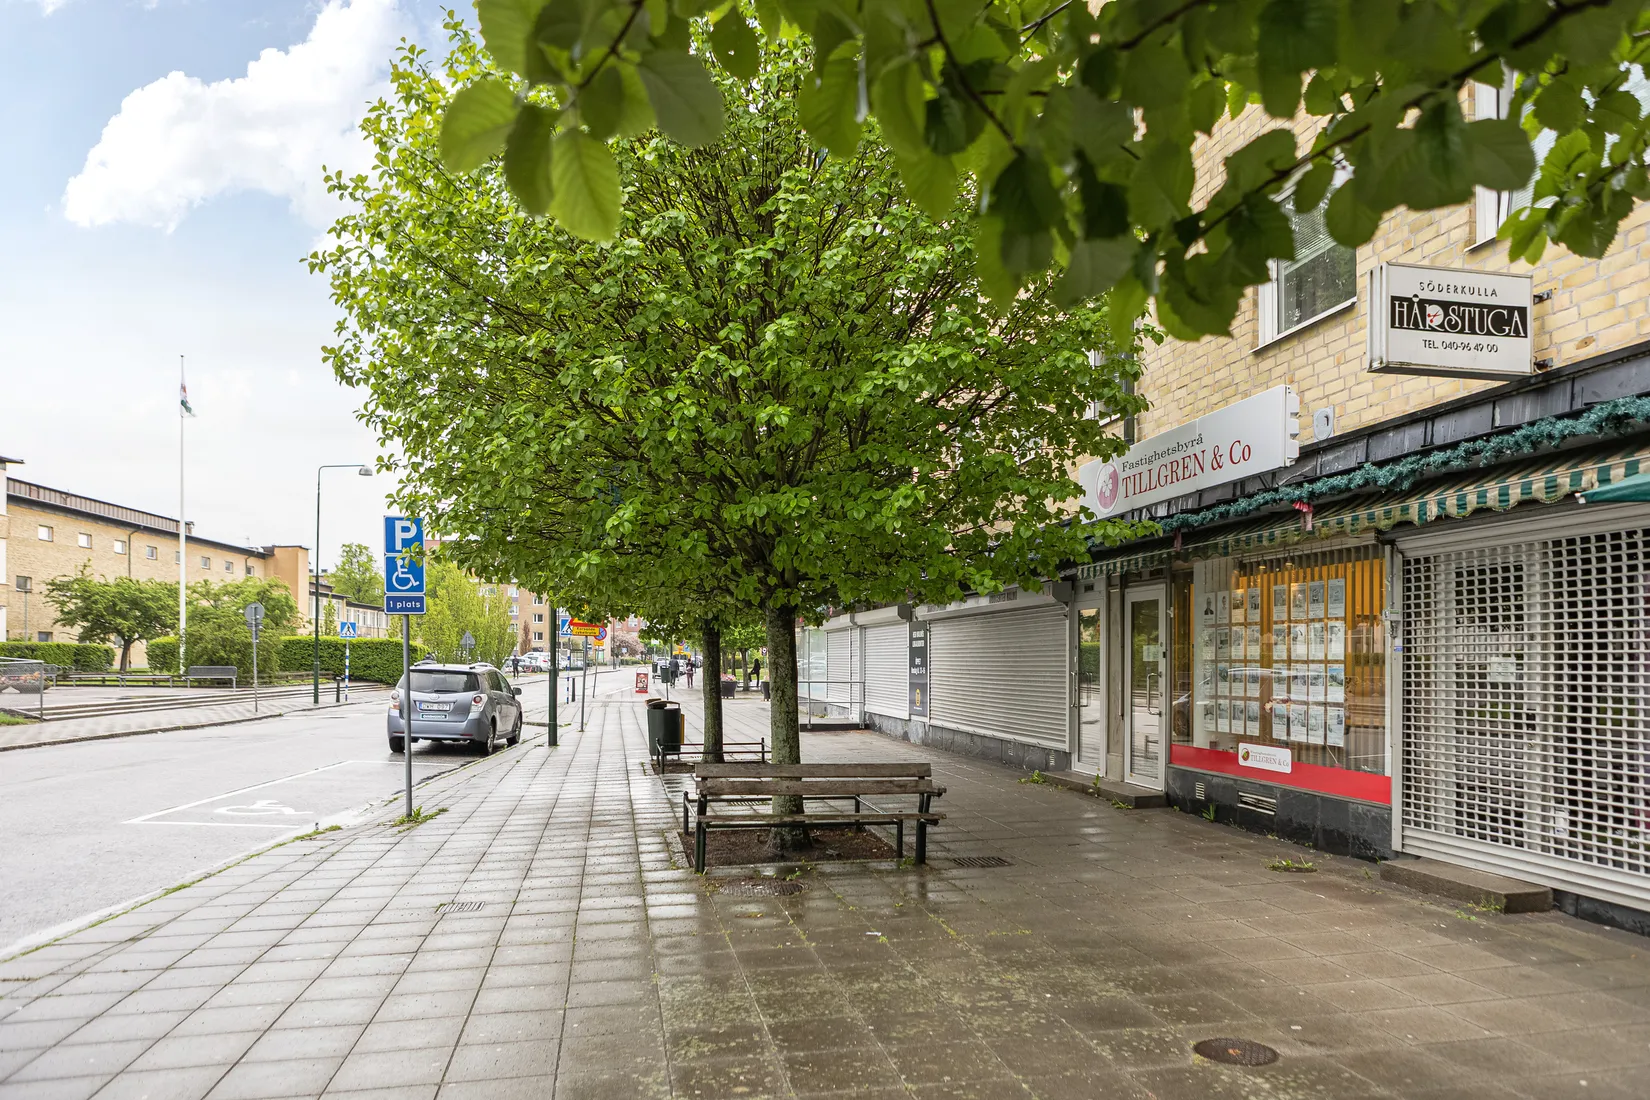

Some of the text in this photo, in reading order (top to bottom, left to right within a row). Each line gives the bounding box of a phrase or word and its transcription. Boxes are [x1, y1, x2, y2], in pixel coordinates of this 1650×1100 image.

[1419, 280, 1498, 298] SÖDERKULLA
[1393, 294, 1526, 337] HÅRSTUGA
[1422, 339, 1498, 353] TEL. 040-96 49 00
[1121, 433, 1204, 473] Fastighetsbyrå
[1121, 439, 1252, 499] TILLGREN & Co
[394, 520, 417, 551] P
[389, 600, 421, 609] 1 plats
[1250, 754, 1278, 765] TILLGREN
